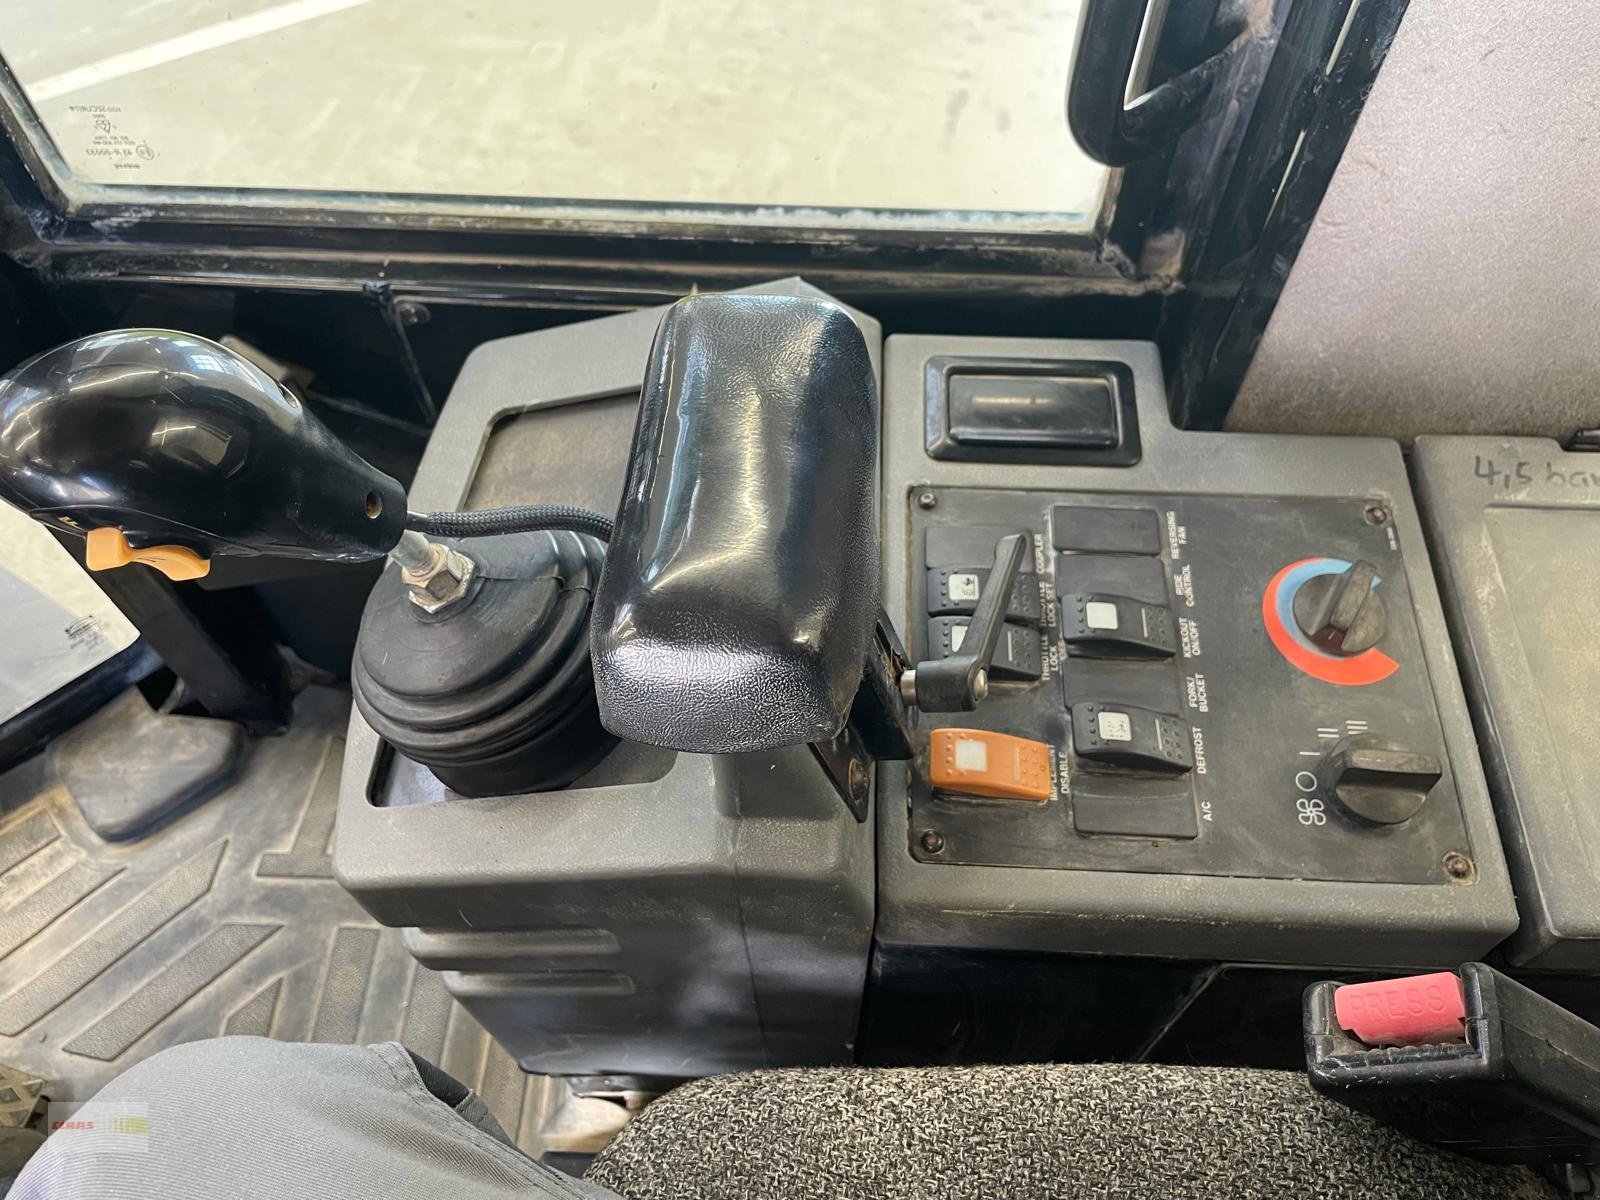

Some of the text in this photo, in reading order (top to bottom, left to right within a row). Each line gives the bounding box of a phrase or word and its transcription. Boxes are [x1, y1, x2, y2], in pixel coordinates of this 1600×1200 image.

[1034, 533, 1045, 574] COUPLER
[1166, 511, 1180, 559] REVERSING
[1177, 526, 1187, 544] FAN
[1174, 573, 1185, 595] RIDE
[1181, 563, 1195, 607] CONTROL
[1179, 617, 1192, 658] KICKOUT
[1188, 619, 1201, 656] ON/OFF
[1049, 645, 1059, 672] LOCK
[1186, 676, 1198, 707] FORK/
[1195, 672, 1208, 712] BUCKET
[1192, 725, 1206, 774] DEFROST
[1059, 751, 1070, 794] DISABLE
[1202, 800, 1212, 821] A/C
[1350, 985, 1446, 1021] PRESS
